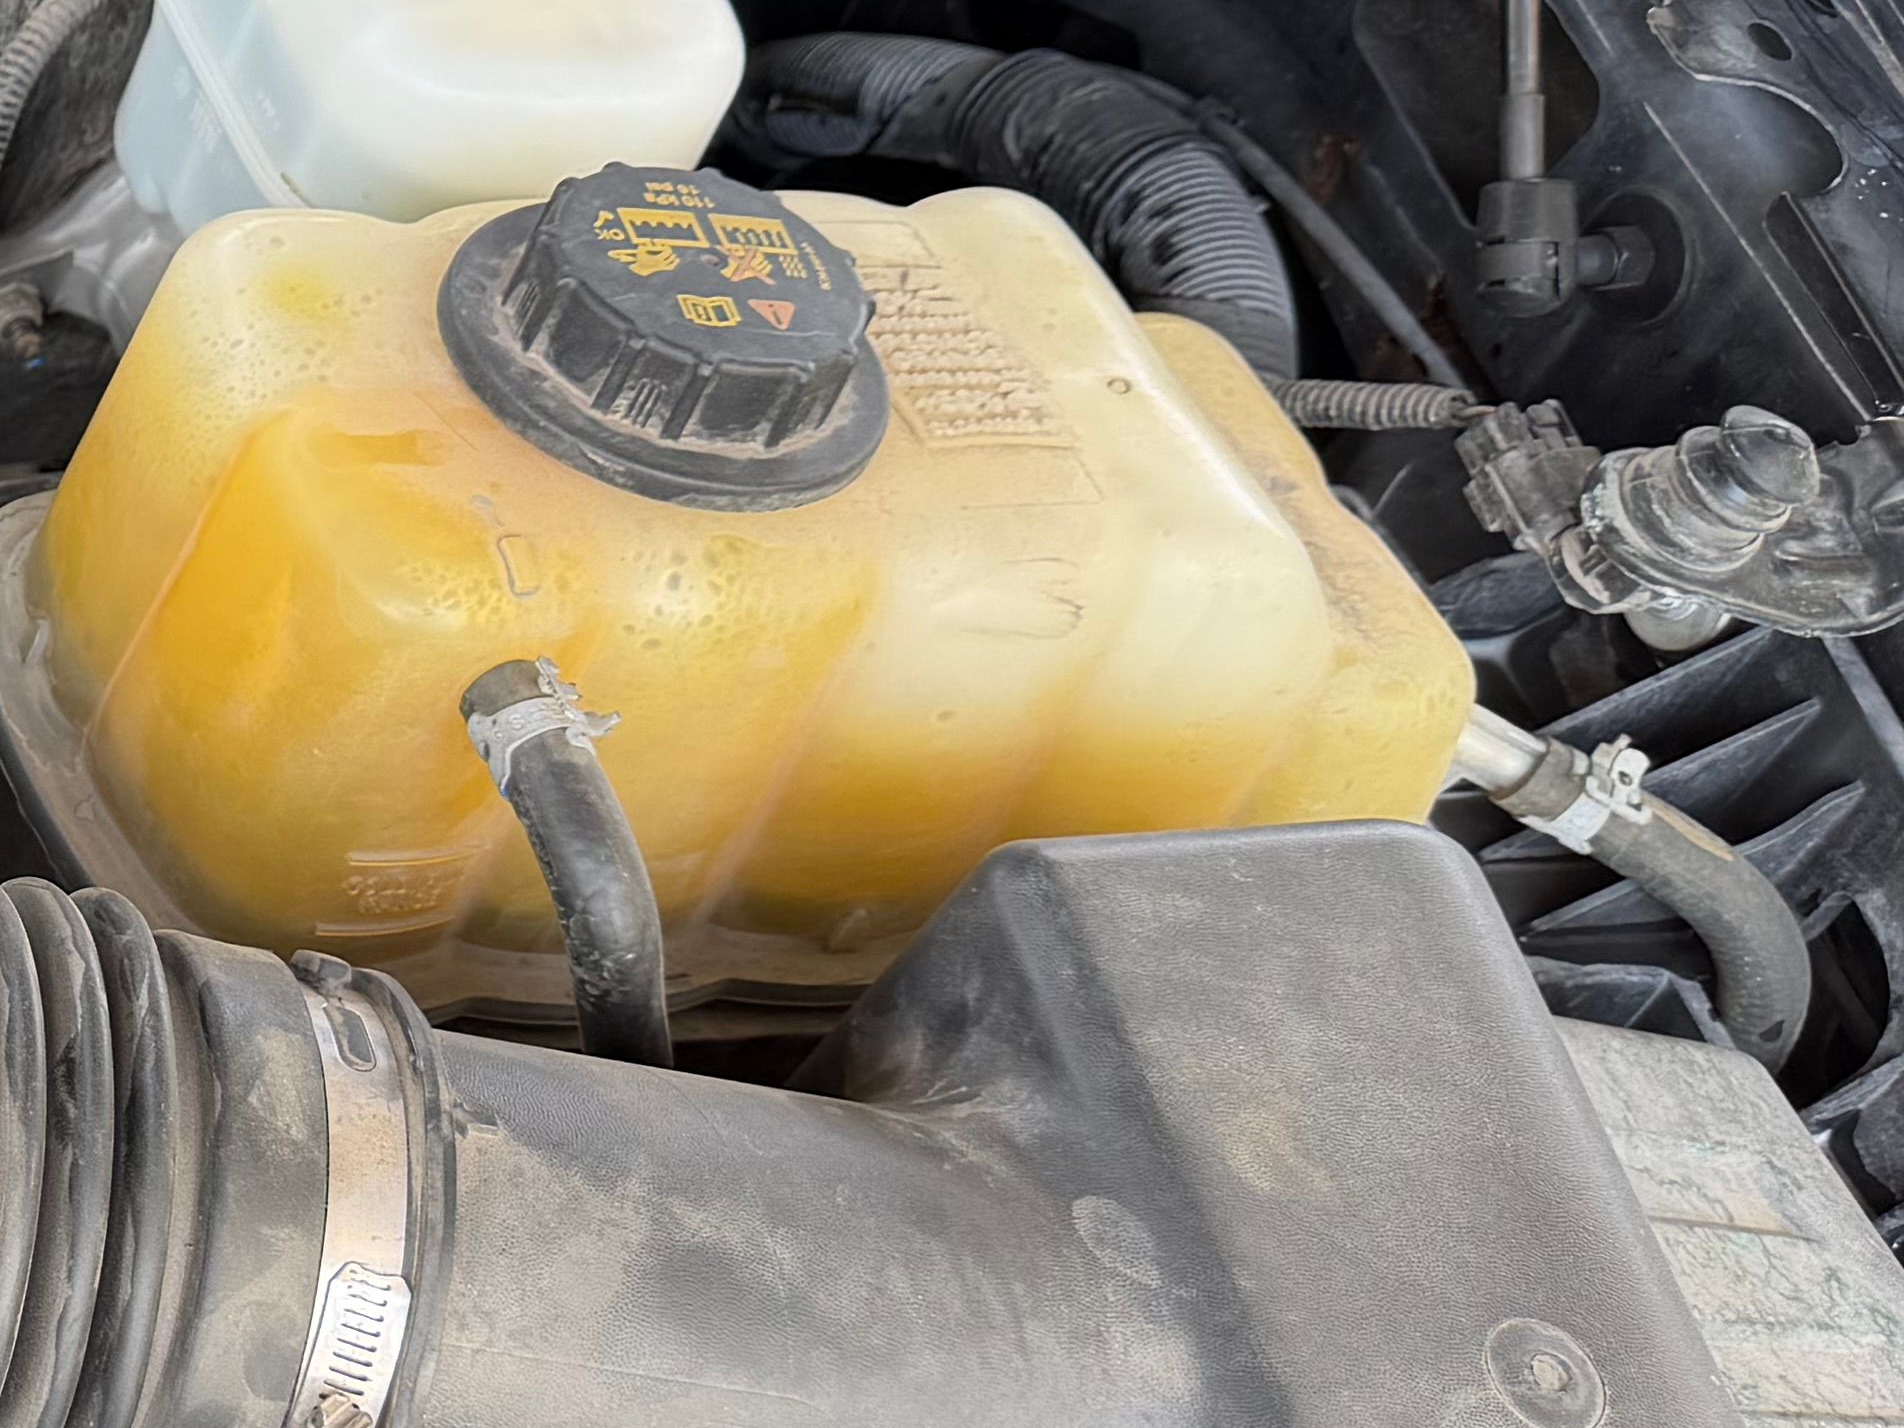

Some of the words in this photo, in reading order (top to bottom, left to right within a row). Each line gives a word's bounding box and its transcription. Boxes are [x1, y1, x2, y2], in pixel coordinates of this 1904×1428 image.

[643, 191, 680, 207] kPa
[681, 194, 715, 209] 110
[594, 227, 625, 241] OK
